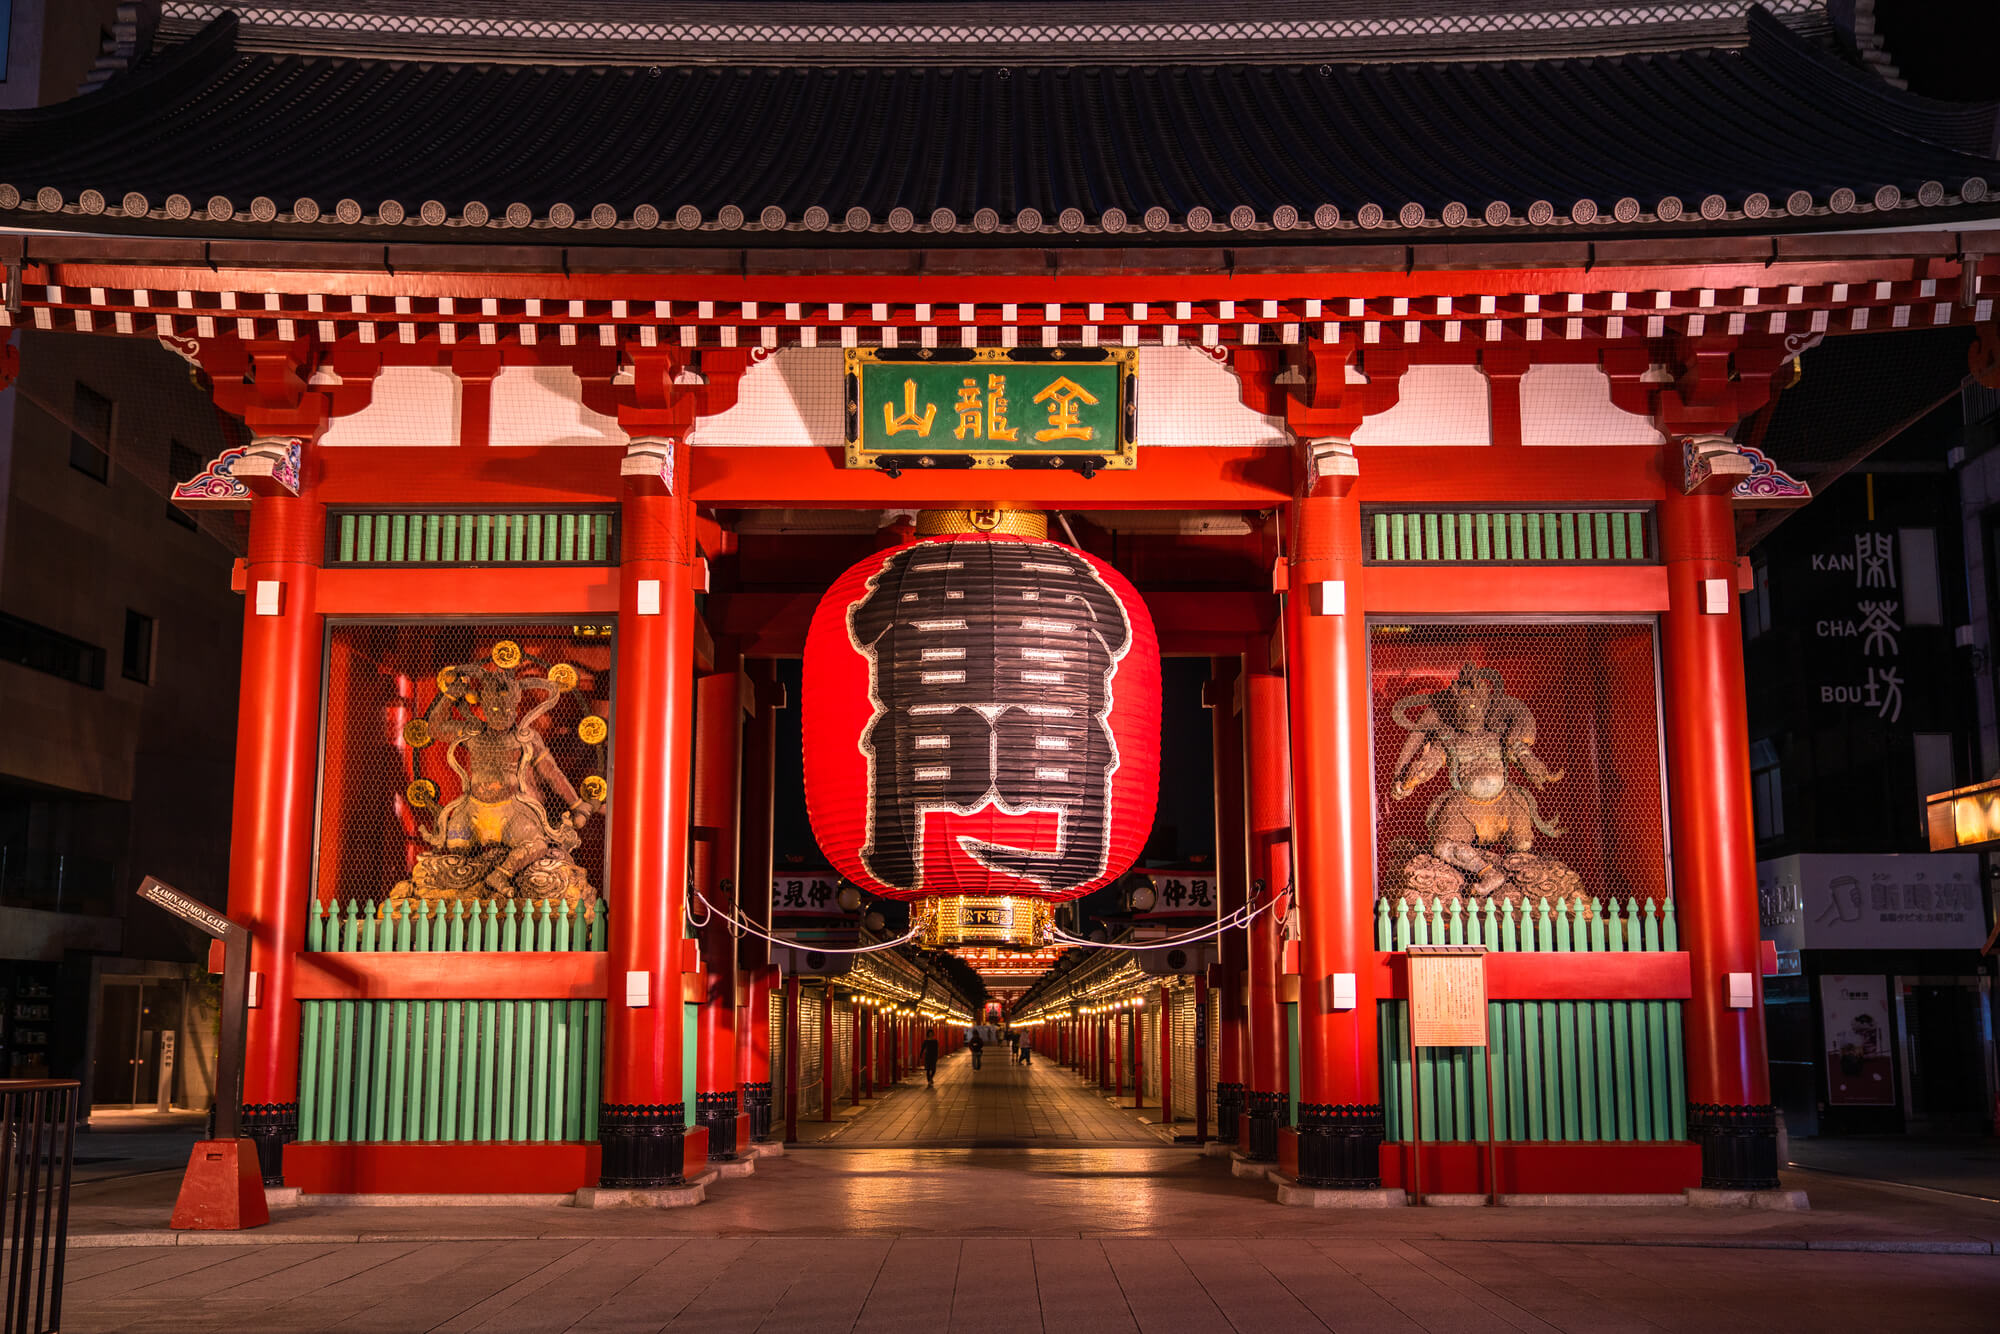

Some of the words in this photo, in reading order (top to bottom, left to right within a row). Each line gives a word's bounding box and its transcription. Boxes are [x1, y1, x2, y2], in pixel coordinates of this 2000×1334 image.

[1812, 554, 1855, 571] KAN
[1816, 620, 1859, 638] CHA
[1821, 685, 1861, 703] BOU
[846, 541, 1133, 892] 雷門
[1163, 879, 1217, 908] 仲見
[152, 885, 209, 920] KAMINARIMON
[206, 914, 229, 931] GATE
